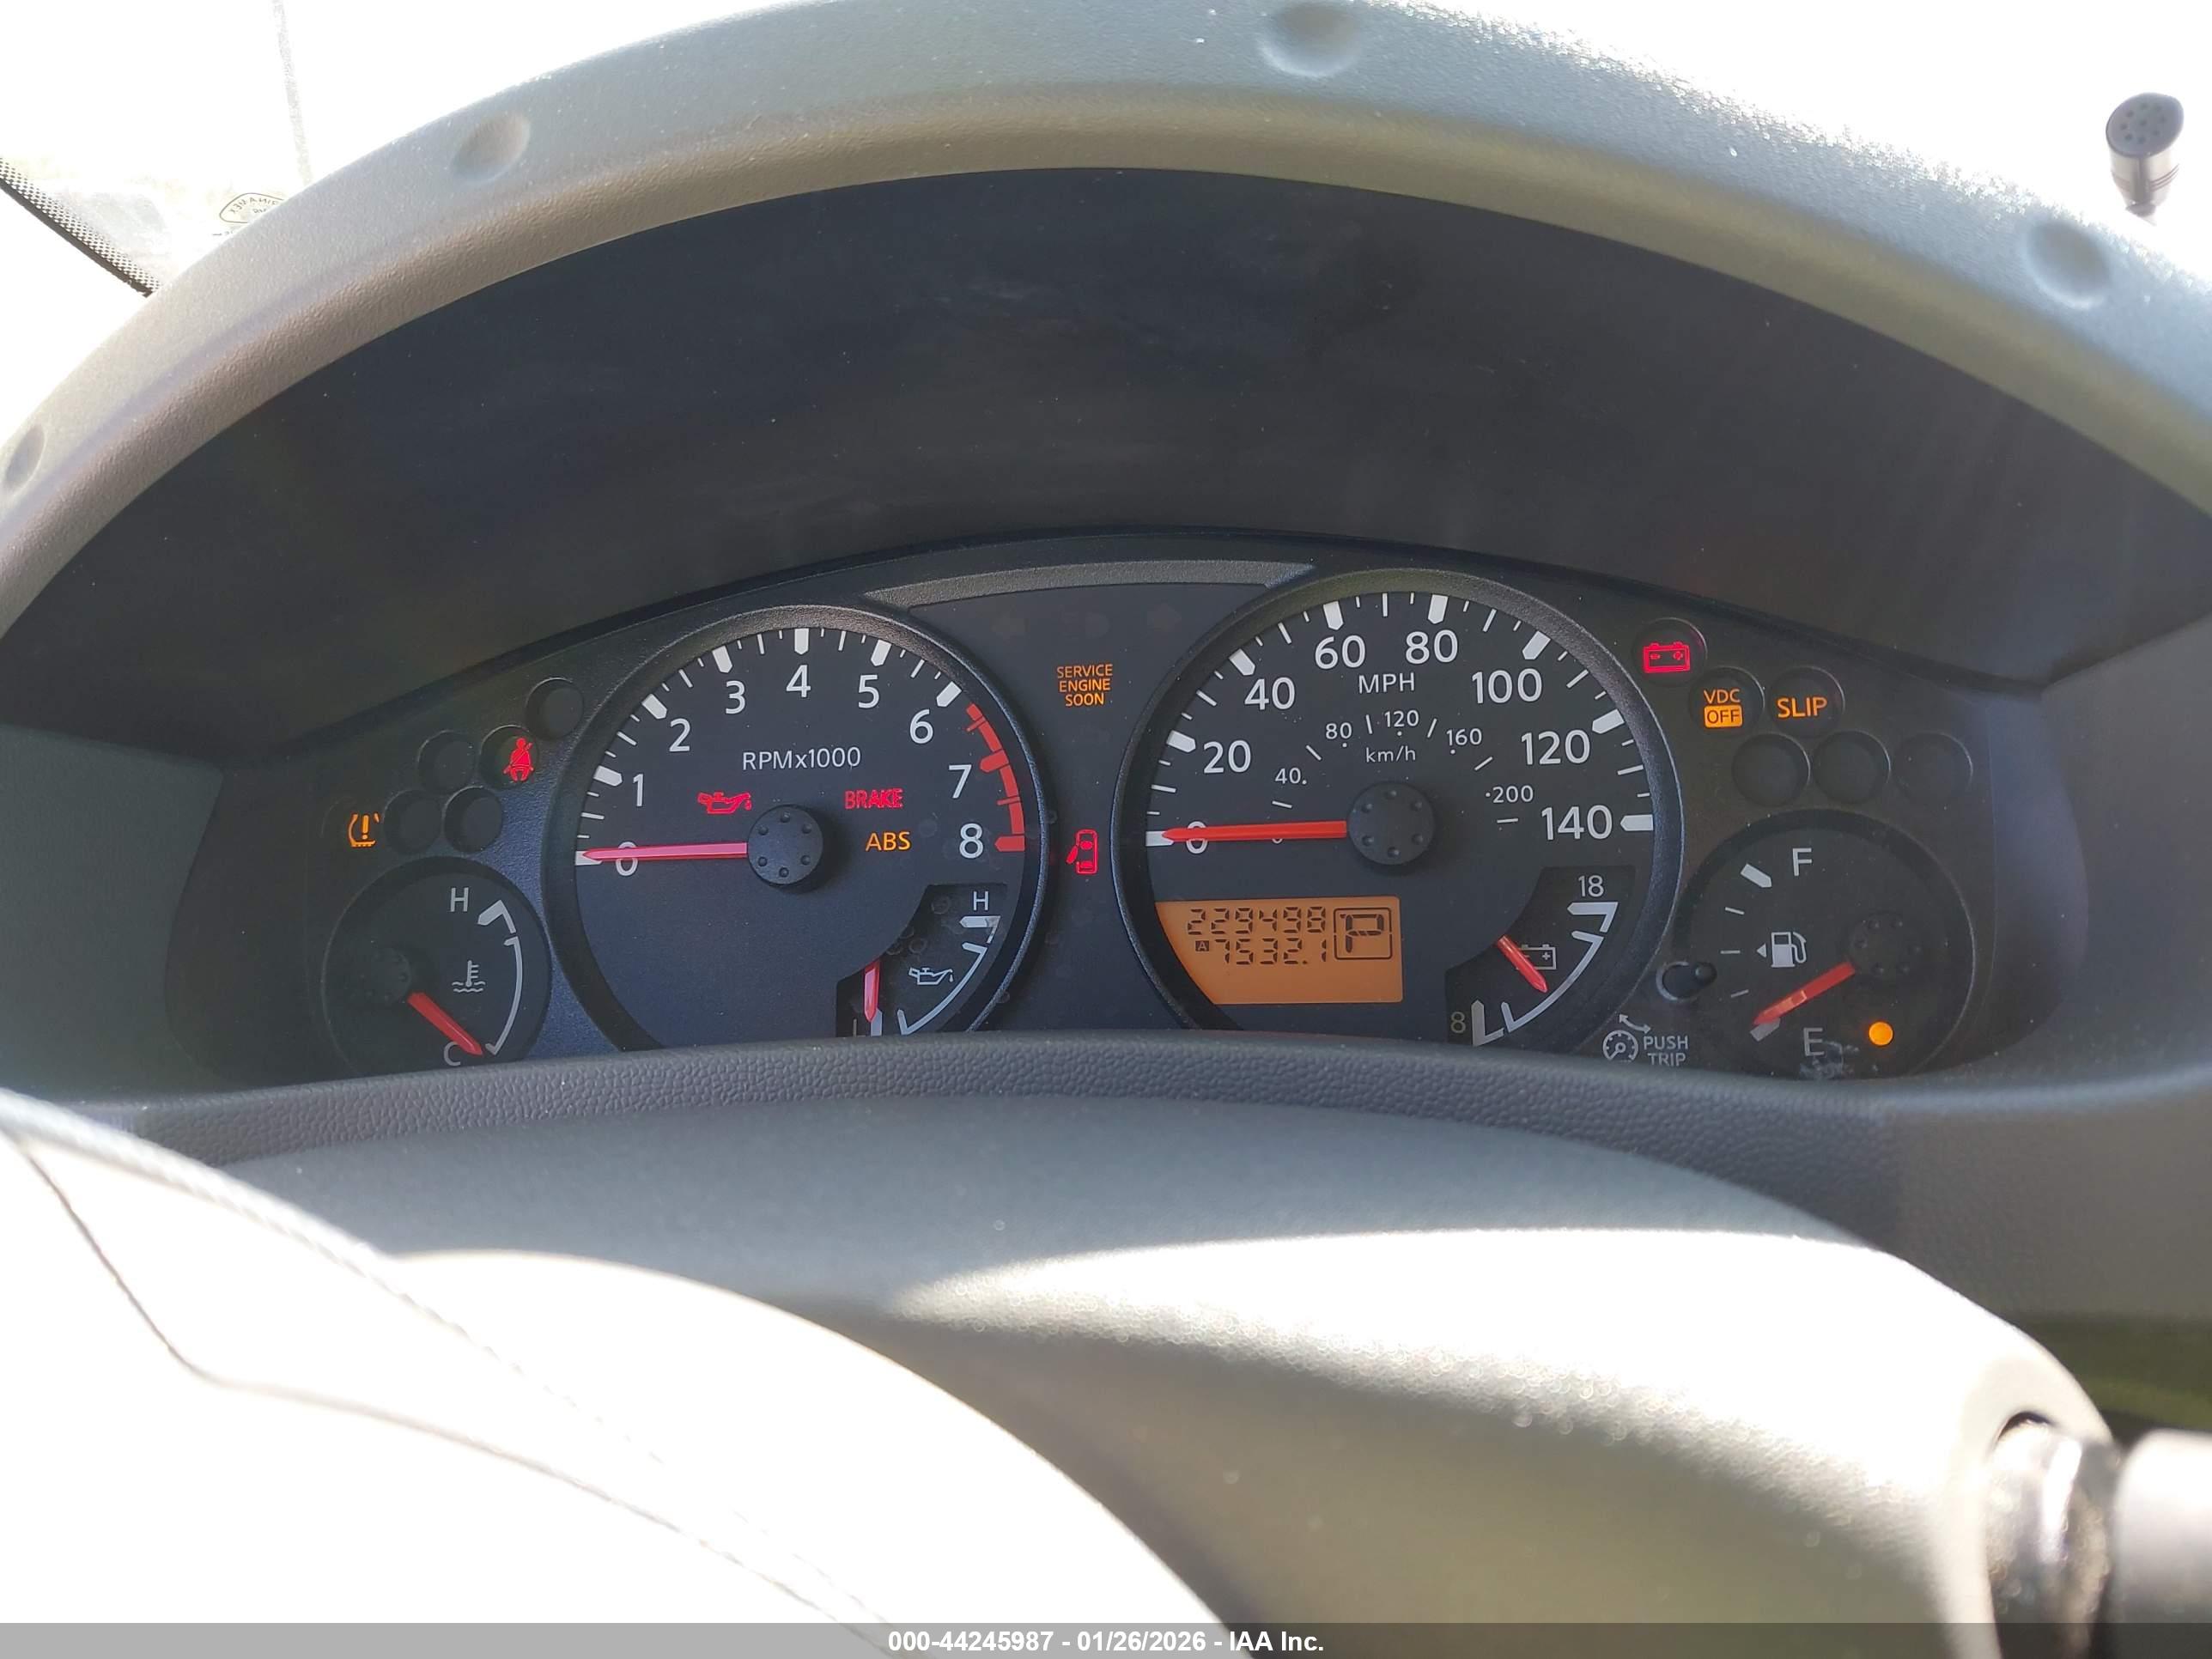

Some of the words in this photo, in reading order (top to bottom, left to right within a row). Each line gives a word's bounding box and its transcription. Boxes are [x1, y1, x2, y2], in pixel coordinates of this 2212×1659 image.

[1315, 635, 1365, 670] 60
[1406, 629, 1458, 665] 80
[786, 665, 811, 698] 4
[1057, 664, 1113, 678] SERVICE
[1358, 672, 1414, 694] MPH
[726, 680, 745, 714] 3
[858, 674, 879, 708] 5
[1059, 678, 1111, 692] ENGINE
[1244, 678, 1295, 710] 40
[1472, 668, 1542, 704] 100
[1703, 689, 1741, 704] VDC
[1065, 692, 1104, 707] SOON
[1777, 696, 1827, 718] SLIP
[909, 708, 933, 744] 6
[1384, 709, 1419, 727] 120
[1706, 708, 1740, 725] OFF
[669, 718, 690, 752] 2
[1325, 722, 1352, 739] 80
[1446, 727, 1482, 746] 160
[743, 746, 861, 770] RPMx1000
[1203, 739, 1251, 774] 20
[1365, 745, 1416, 763] km/h
[1521, 729, 1590, 765] 120
[633, 774, 644, 807] 1
[948, 764, 972, 799] 7
[1492, 785, 1534, 804] 200
[845, 787, 903, 809] BRAKE
[1541, 805, 1613, 841] 140
[866, 831, 910, 851] ABS
[959, 823, 984, 859] 8
[1186, 821, 1208, 854] 0
[616, 841, 638, 877] 0
[1792, 848, 1813, 877] F
[1578, 875, 1604, 897] 18
[450, 887, 469, 913] H
[973, 890, 989, 911] H
[1188, 906, 1327, 935] 229498
[1340, 914, 1385, 954] P
[1214, 938, 1327, 965] 7532.1
[1450, 1012, 1467, 1033] 8
[443, 1041, 462, 1066] C
[1643, 1035, 1689, 1050] PUSH
[1803, 1027, 1825, 1056] E
[1647, 1052, 1686, 1066] TRIP
